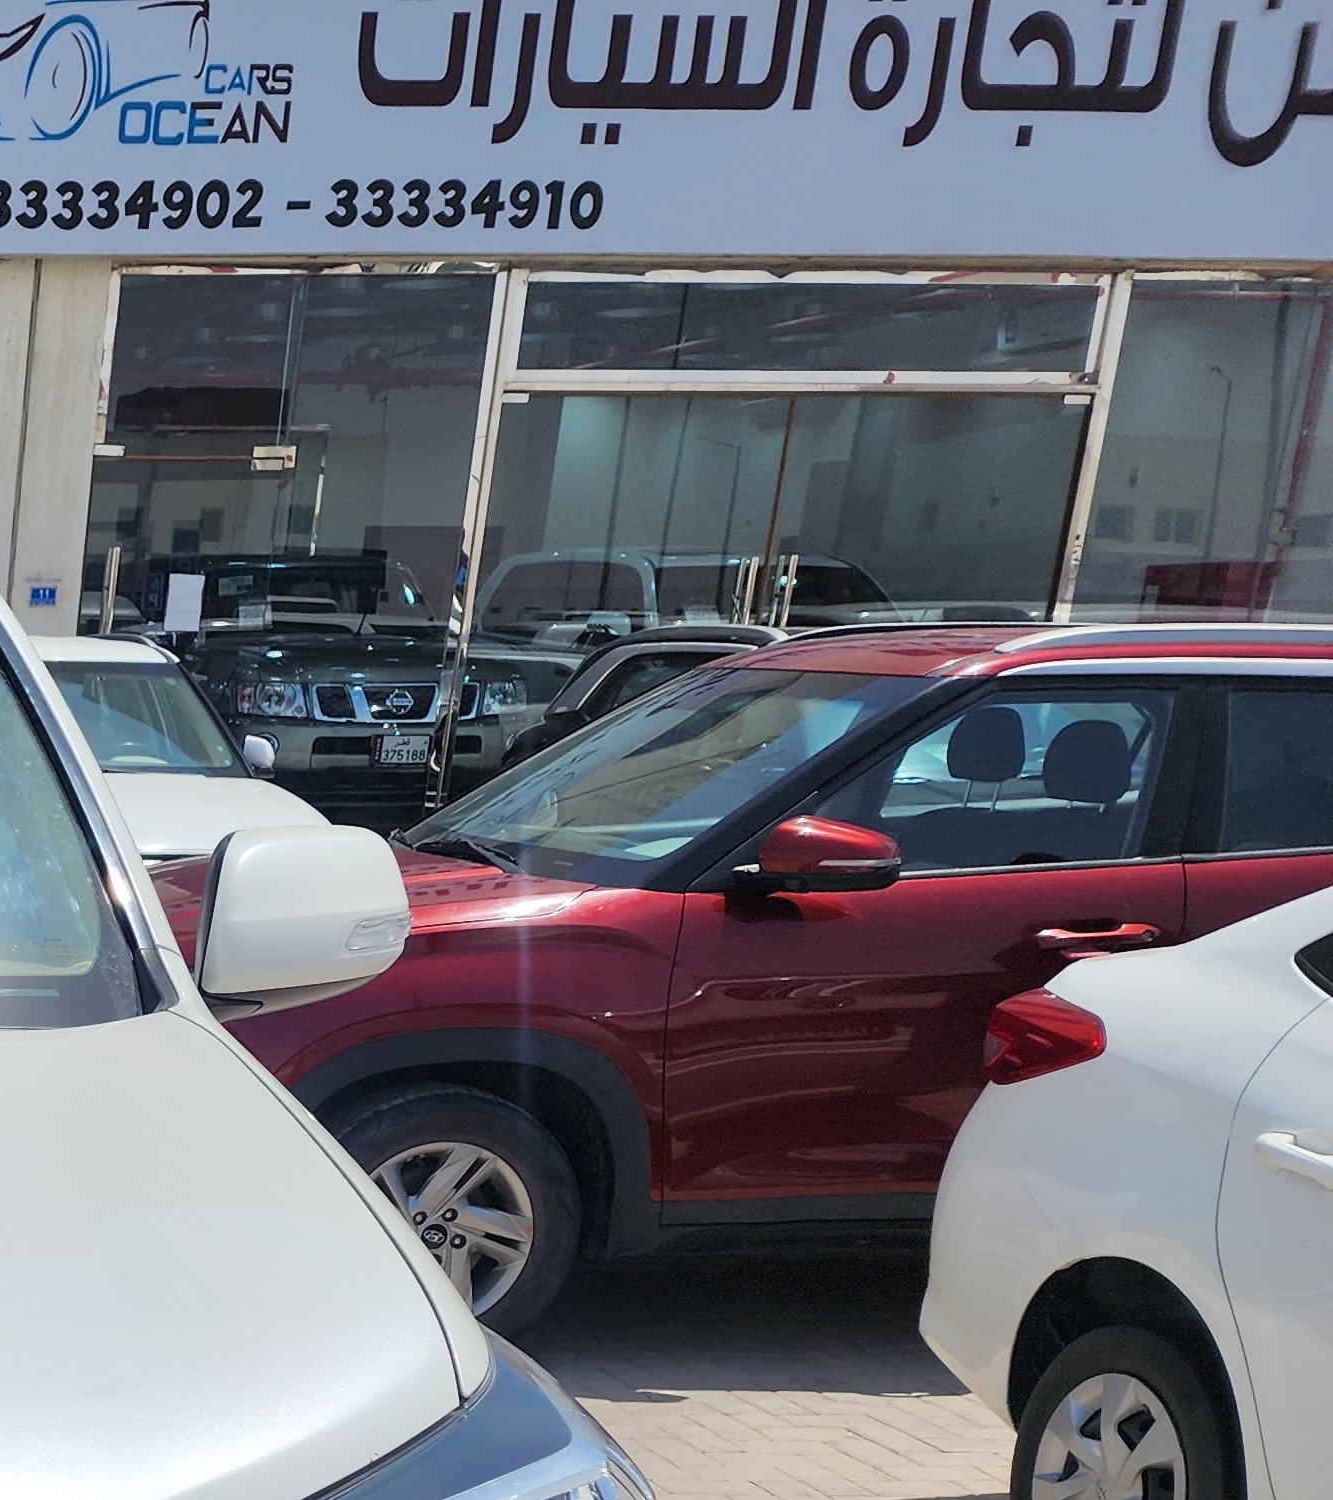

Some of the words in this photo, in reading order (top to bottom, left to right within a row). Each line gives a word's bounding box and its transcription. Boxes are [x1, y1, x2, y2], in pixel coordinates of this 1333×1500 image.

[204, 62, 295, 96] CARS
[117, 99, 293, 147] OCEAN
[324, 178, 604, 232] 33334910
[382, 749, 426, 762] 375188
